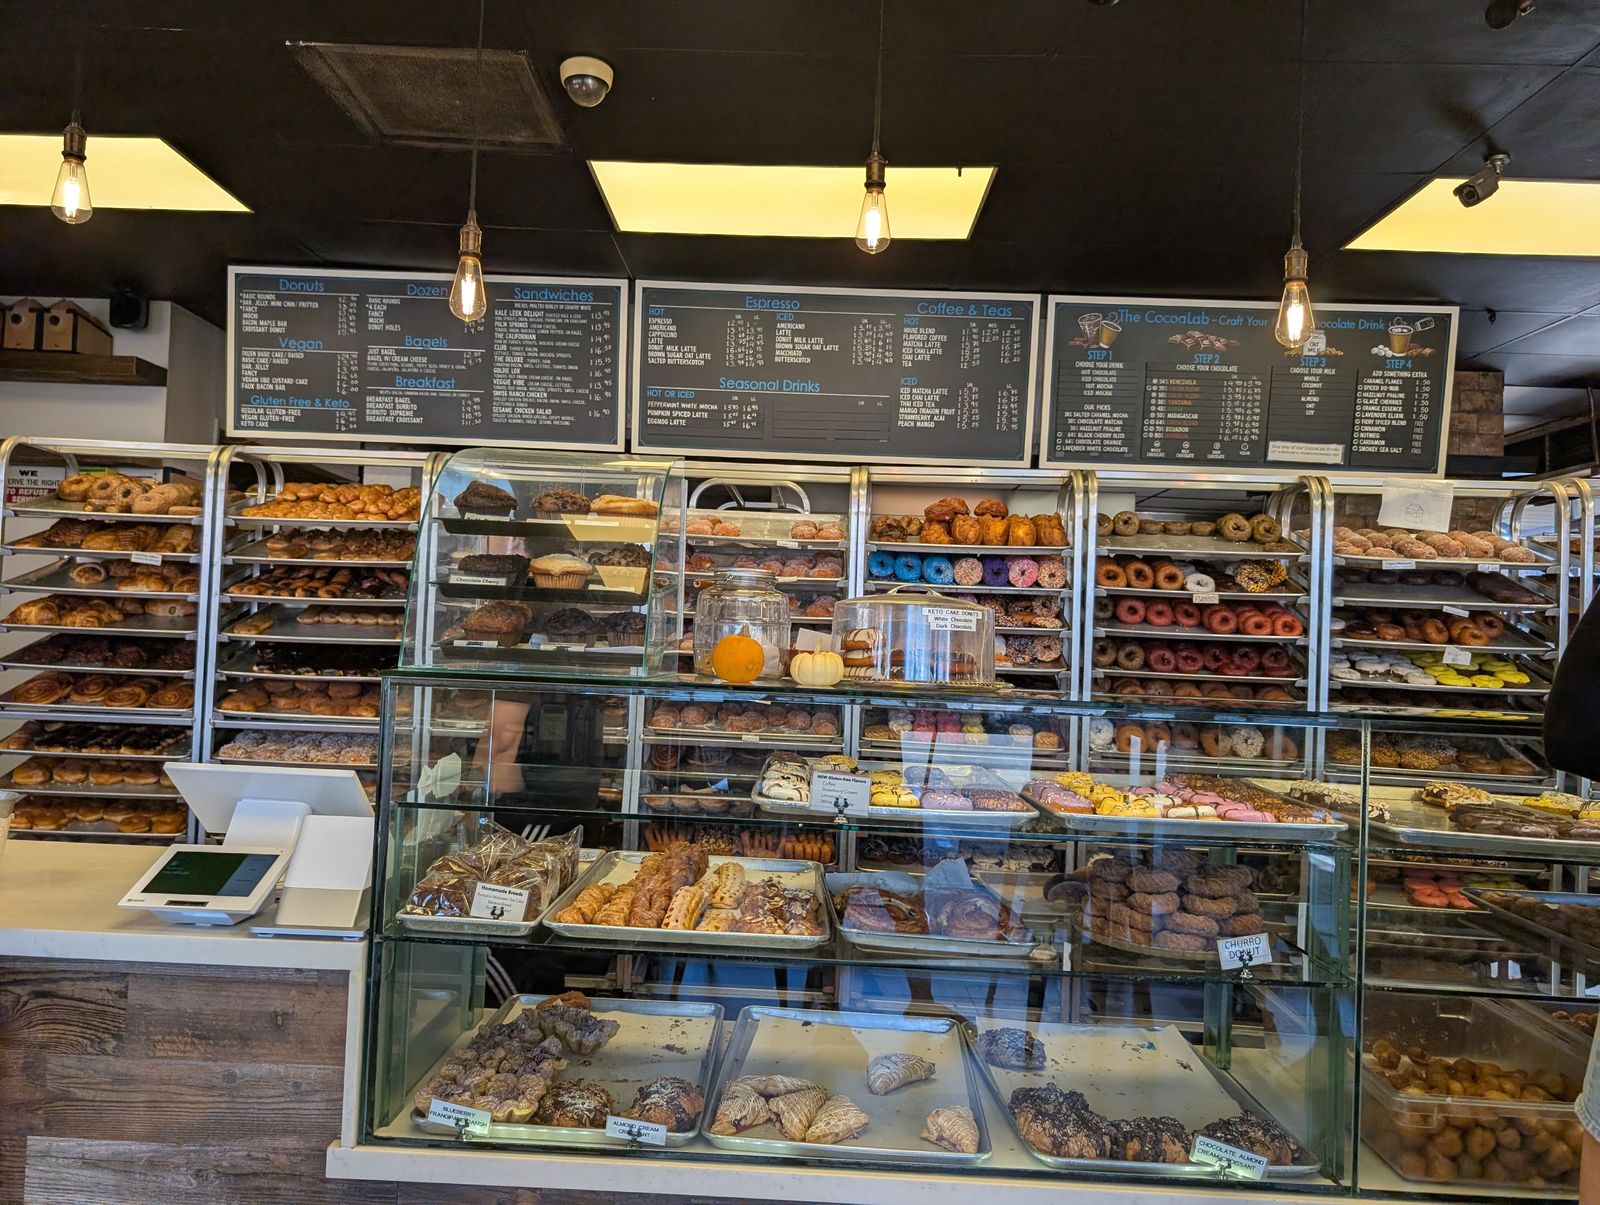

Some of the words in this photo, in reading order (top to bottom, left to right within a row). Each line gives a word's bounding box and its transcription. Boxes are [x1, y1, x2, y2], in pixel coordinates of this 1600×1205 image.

[280, 280, 324, 293] Donuts
[407, 284, 448, 296] Dozen
[514, 287, 594, 302] Sandwiches
[746, 296, 800, 311] Espresso
[649, 308, 664, 316] HOT
[917, 303, 964, 315] Coffee
[968, 305, 977, 316] &
[981, 305, 1013, 317] Teas
[777, 313, 794, 321] ICED
[904, 317, 919, 325] HOT
[1119, 309, 1140, 322] The
[1145, 310, 1209, 325] CocoaLab
[1218, 315, 1243, 326] Craft
[1246, 316, 1269, 328] Your
[1358, 319, 1385, 330] Drink
[505, 333, 537, 341] CALIFORNIAN
[279, 338, 323, 352] Vegan
[405, 335, 448, 350] Bagels
[696, 353, 712, 361] LATTE
[1088, 350, 1107, 360] STEP
[1194, 354, 1213, 363] STEP
[1300, 357, 1319, 367] STEP
[1321, 357, 1327, 367] 3
[1386, 360, 1405, 369] STEP
[395, 375, 456, 390] Breakfast
[493, 378, 512, 386] VEGGIE
[720, 377, 779, 391] Seasonal
[783, 379, 820, 392] Drinks
[901, 378, 918, 386] ICED
[647, 390, 661, 398] HOT
[678, 391, 695, 399] ICED
[251, 396, 286, 406] Gluten
[290, 397, 311, 407] Free
[314, 399, 322, 408] &
[325, 399, 350, 409] Keto
[692, 411, 709, 419] LATTE
[19, 469, 38, 477] WE
[19, 488, 48, 496] REFUSE
[482, 885, 507, 894] Homemade
[1224, 936, 1262, 949] CHURRO
[430, 1110, 466, 1122] FRANGIPAN
[443, 1106, 476, 1117] BLUEBERRY
[613, 1120, 637, 1129] ALMOND
[1199, 1140, 1237, 1157] CHOCOLATE
[1239, 1153, 1265, 1166] ALMOND
